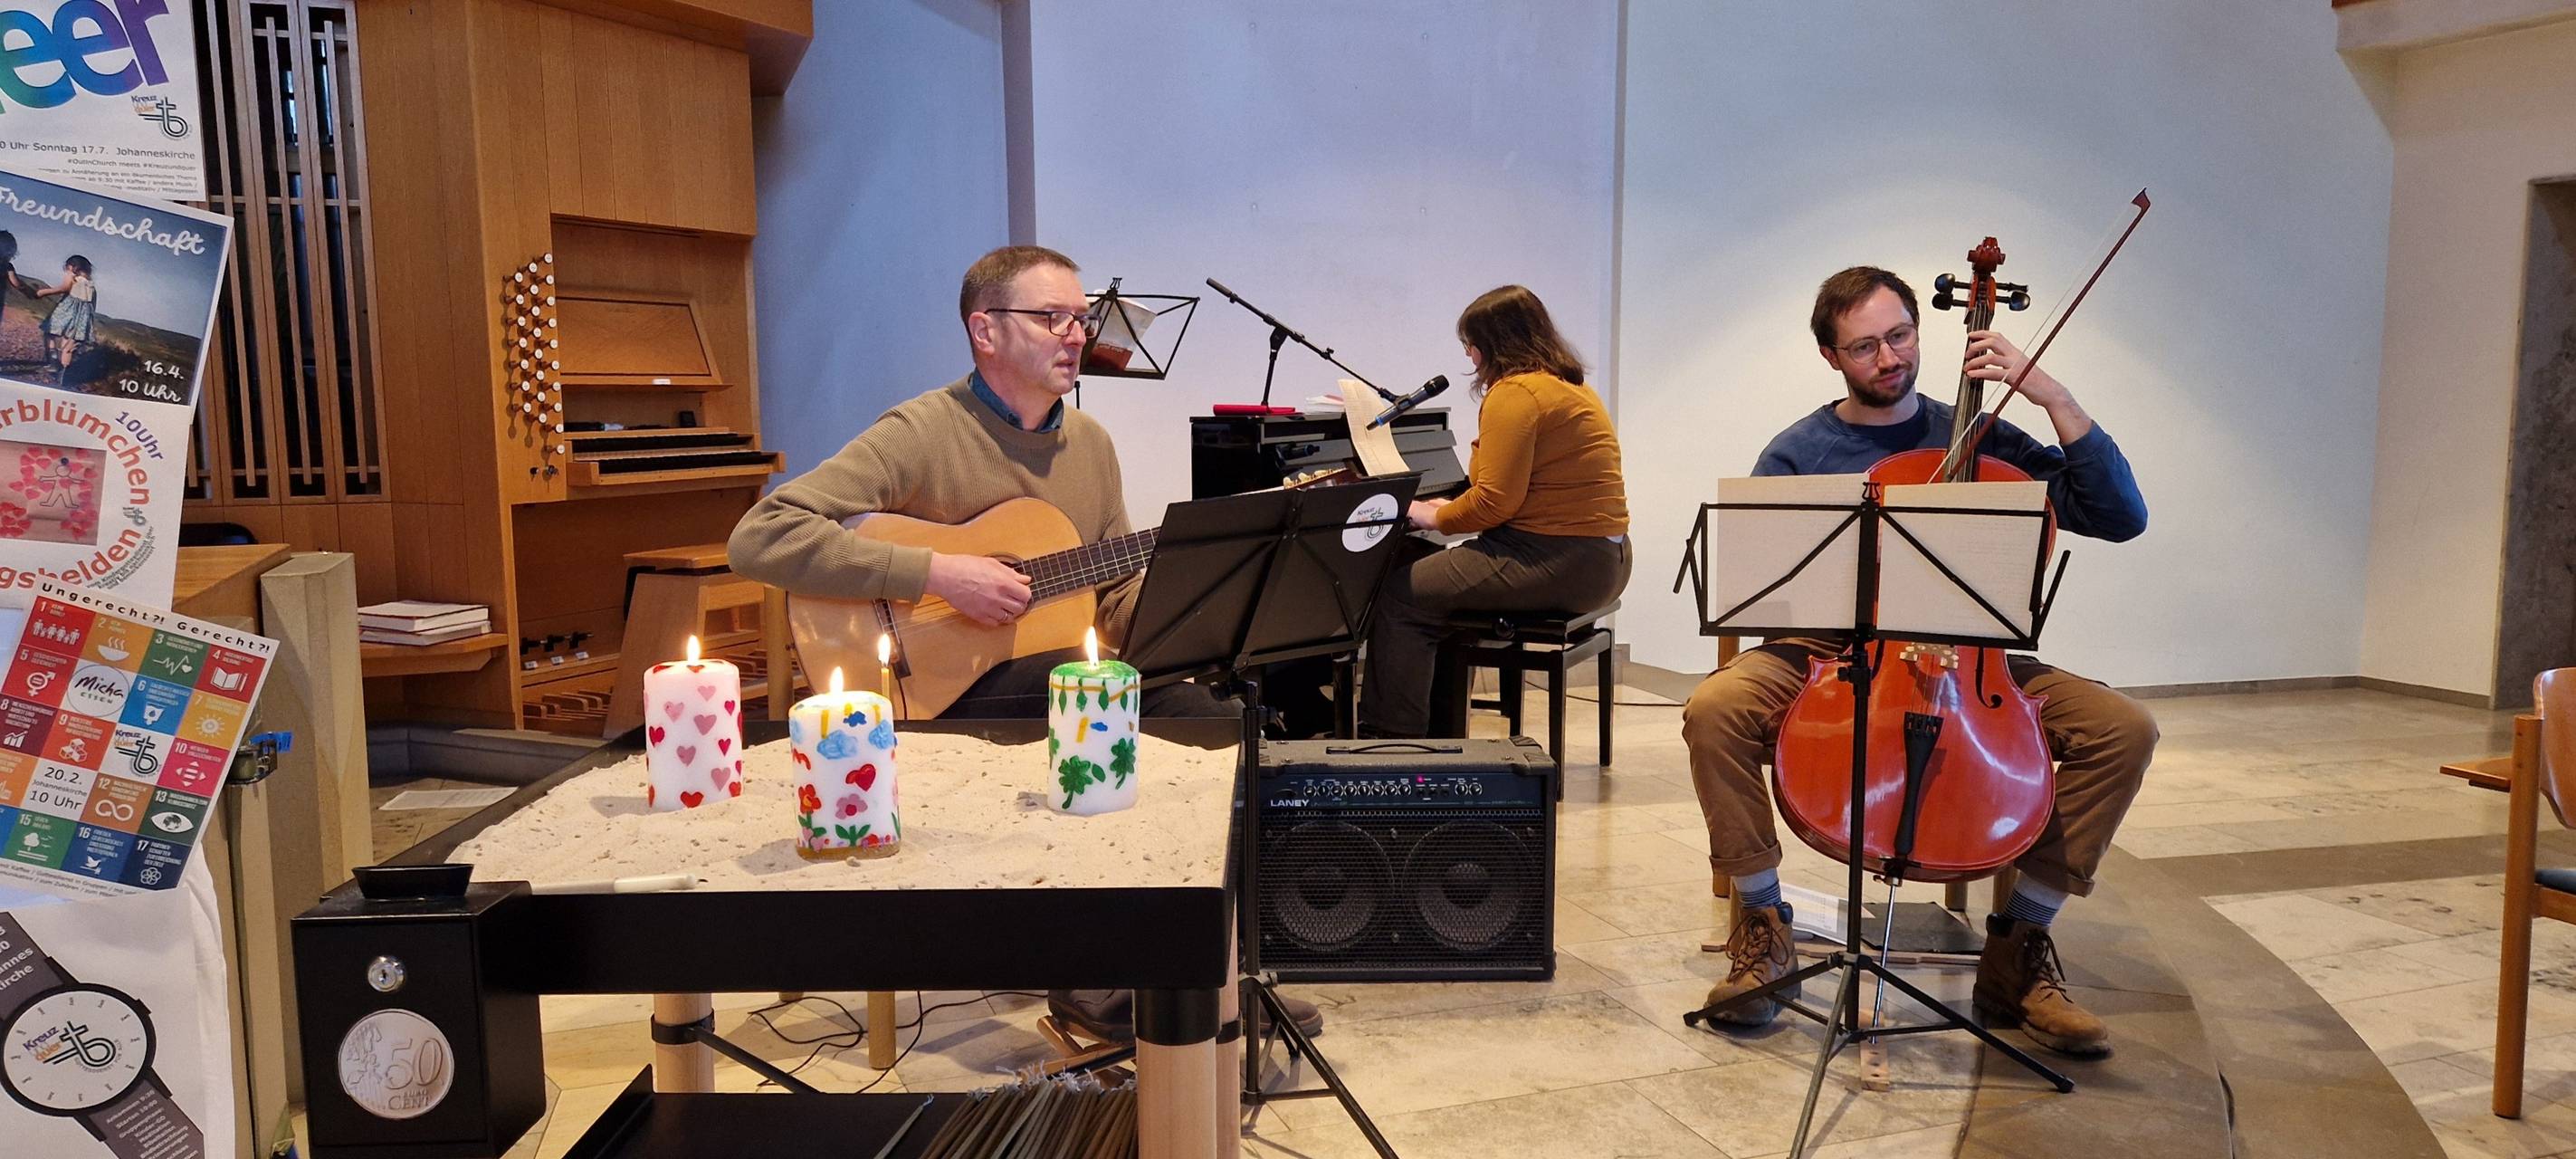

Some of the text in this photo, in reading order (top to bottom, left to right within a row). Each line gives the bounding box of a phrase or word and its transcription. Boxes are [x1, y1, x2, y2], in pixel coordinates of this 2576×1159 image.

[0, 0, 170, 113] eer
[10, 141, 29, 150] Uhr
[33, 142, 78, 155] Sonntag
[81, 146, 109, 155] 17.7.
[116, 147, 196, 159] Johanneskirche
[0, 186, 205, 256] Freundschaft
[144, 359, 184, 379] 16.4.
[119, 378, 181, 403] 10 Uhr
[0, 398, 150, 505] rblümchen
[42, 582, 165, 625] Ungerecht?!
[177, 621, 271, 654] Gerecht?!
[74, 675, 124, 698] Micha
[115, 729, 141, 739] Kreuz
[174, 742, 187, 754] 10
[43, 766, 82, 786] 20.2.
[97, 777, 110, 790] 12
[33, 779, 88, 797] Johanneskirche
[155, 790, 167, 803] 13
[30, 790, 82, 810] 10 Uhr
[1270, 799, 1310, 807] LANEY
[20, 813, 33, 826] 15
[79, 826, 91, 839] 16
[137, 839, 149, 851] 17
[23, 1027, 60, 1051] Kreuz
[385, 1037, 444, 1090] 50
